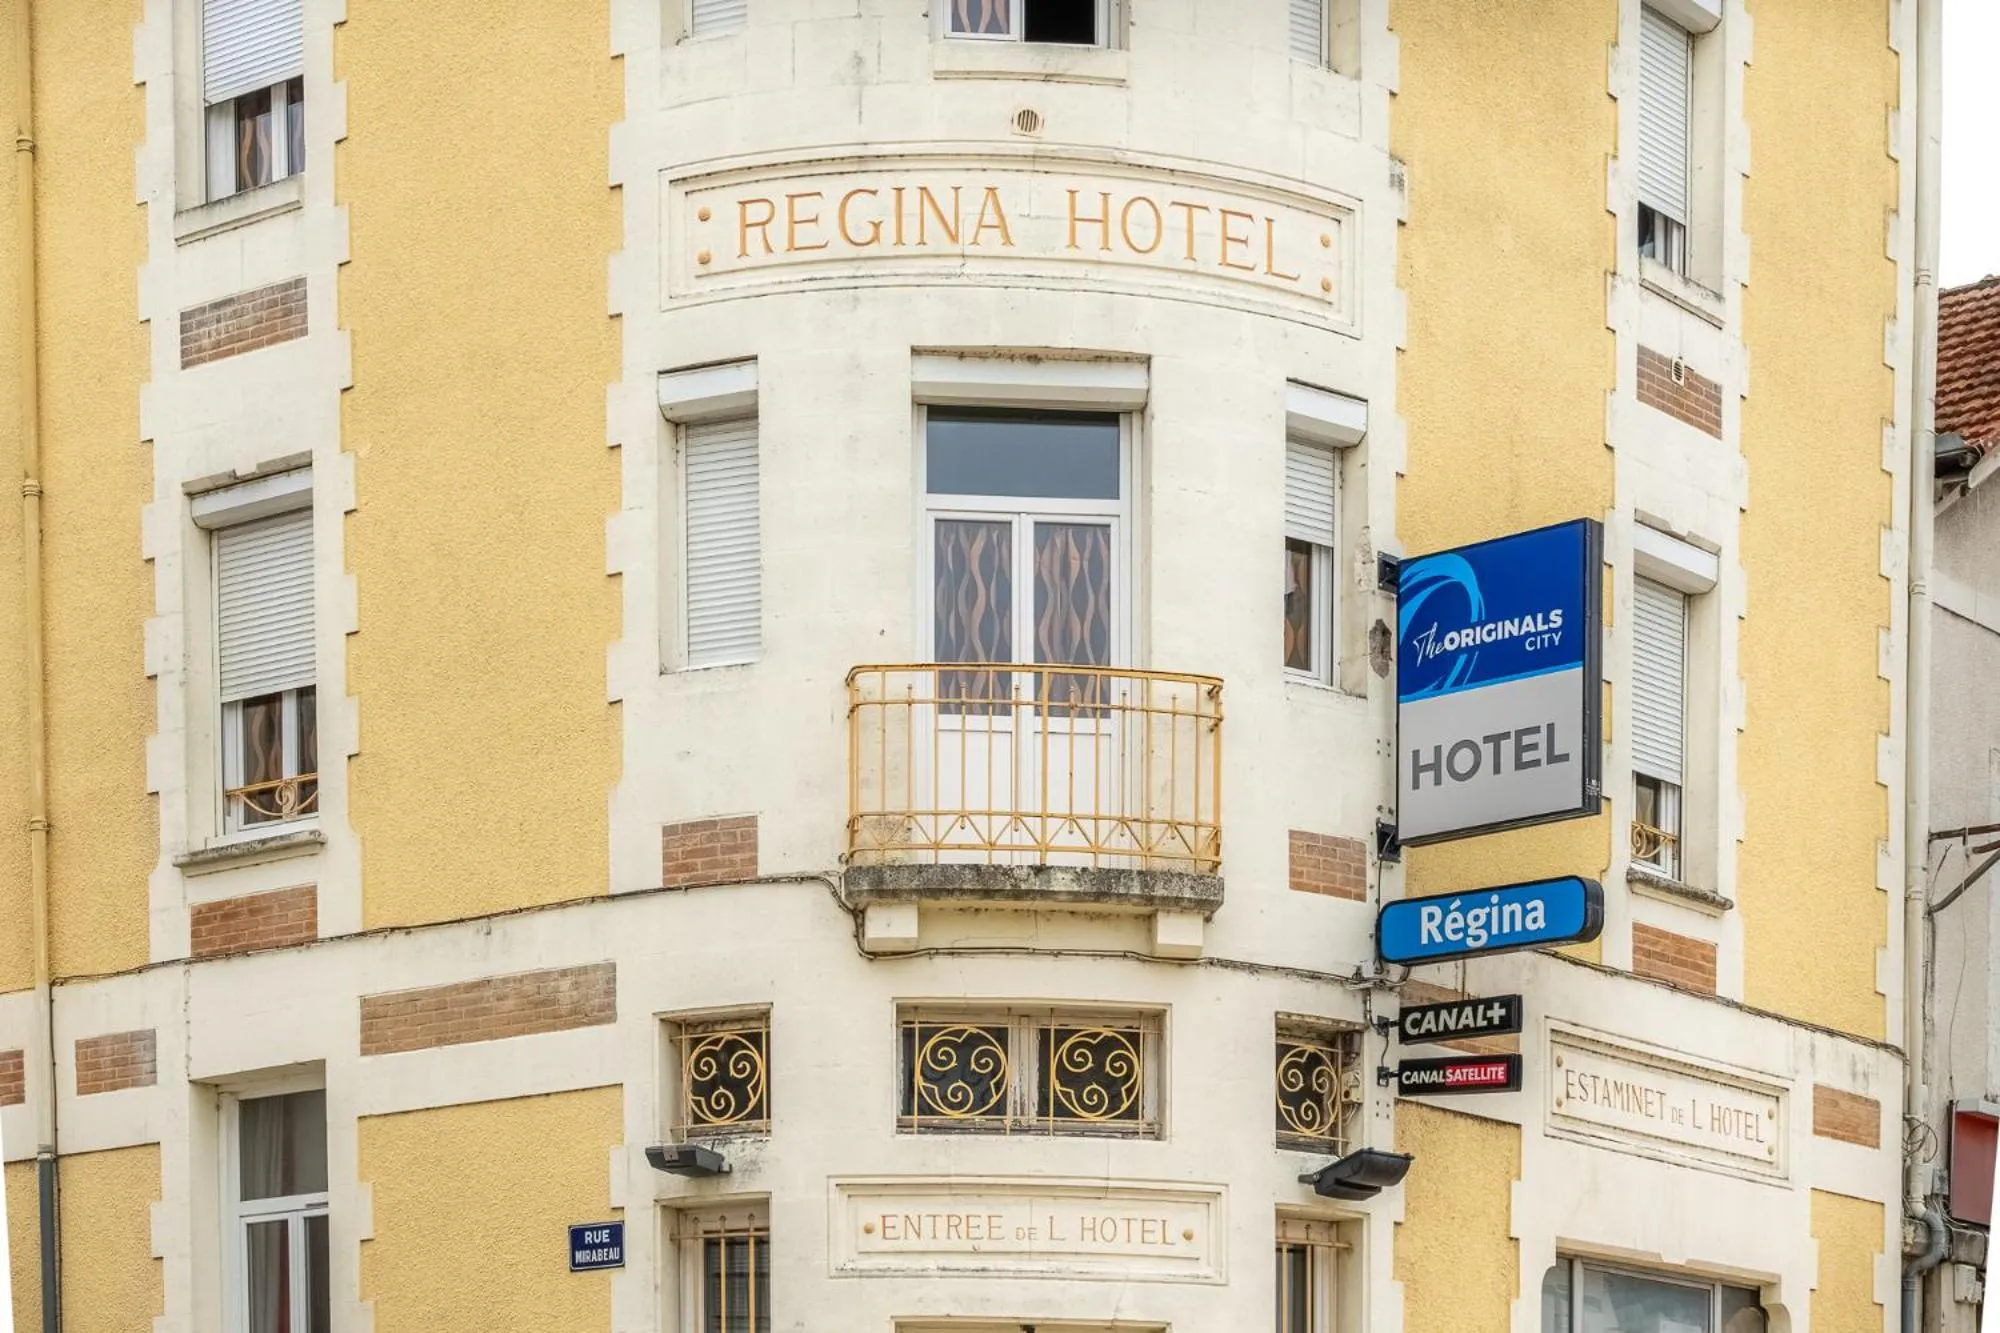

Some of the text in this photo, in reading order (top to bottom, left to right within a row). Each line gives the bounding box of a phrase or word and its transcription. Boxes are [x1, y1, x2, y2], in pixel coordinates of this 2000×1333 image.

[736, 186, 1301, 281] REGINA HOTEL
[1525, 631, 1563, 651] CITY
[1411, 722, 1570, 790] HOTEL
[1420, 894, 1546, 947] Régina
[1404, 1002, 1506, 1035] CANAL+
[1565, 1068, 1765, 1143] ESTAMINET DE L HOTEL
[584, 1229, 610, 1244] RUE
[881, 1214, 1176, 1246] ENTREE DE L HOTEL
[575, 1247, 620, 1265] MIRABEAU
